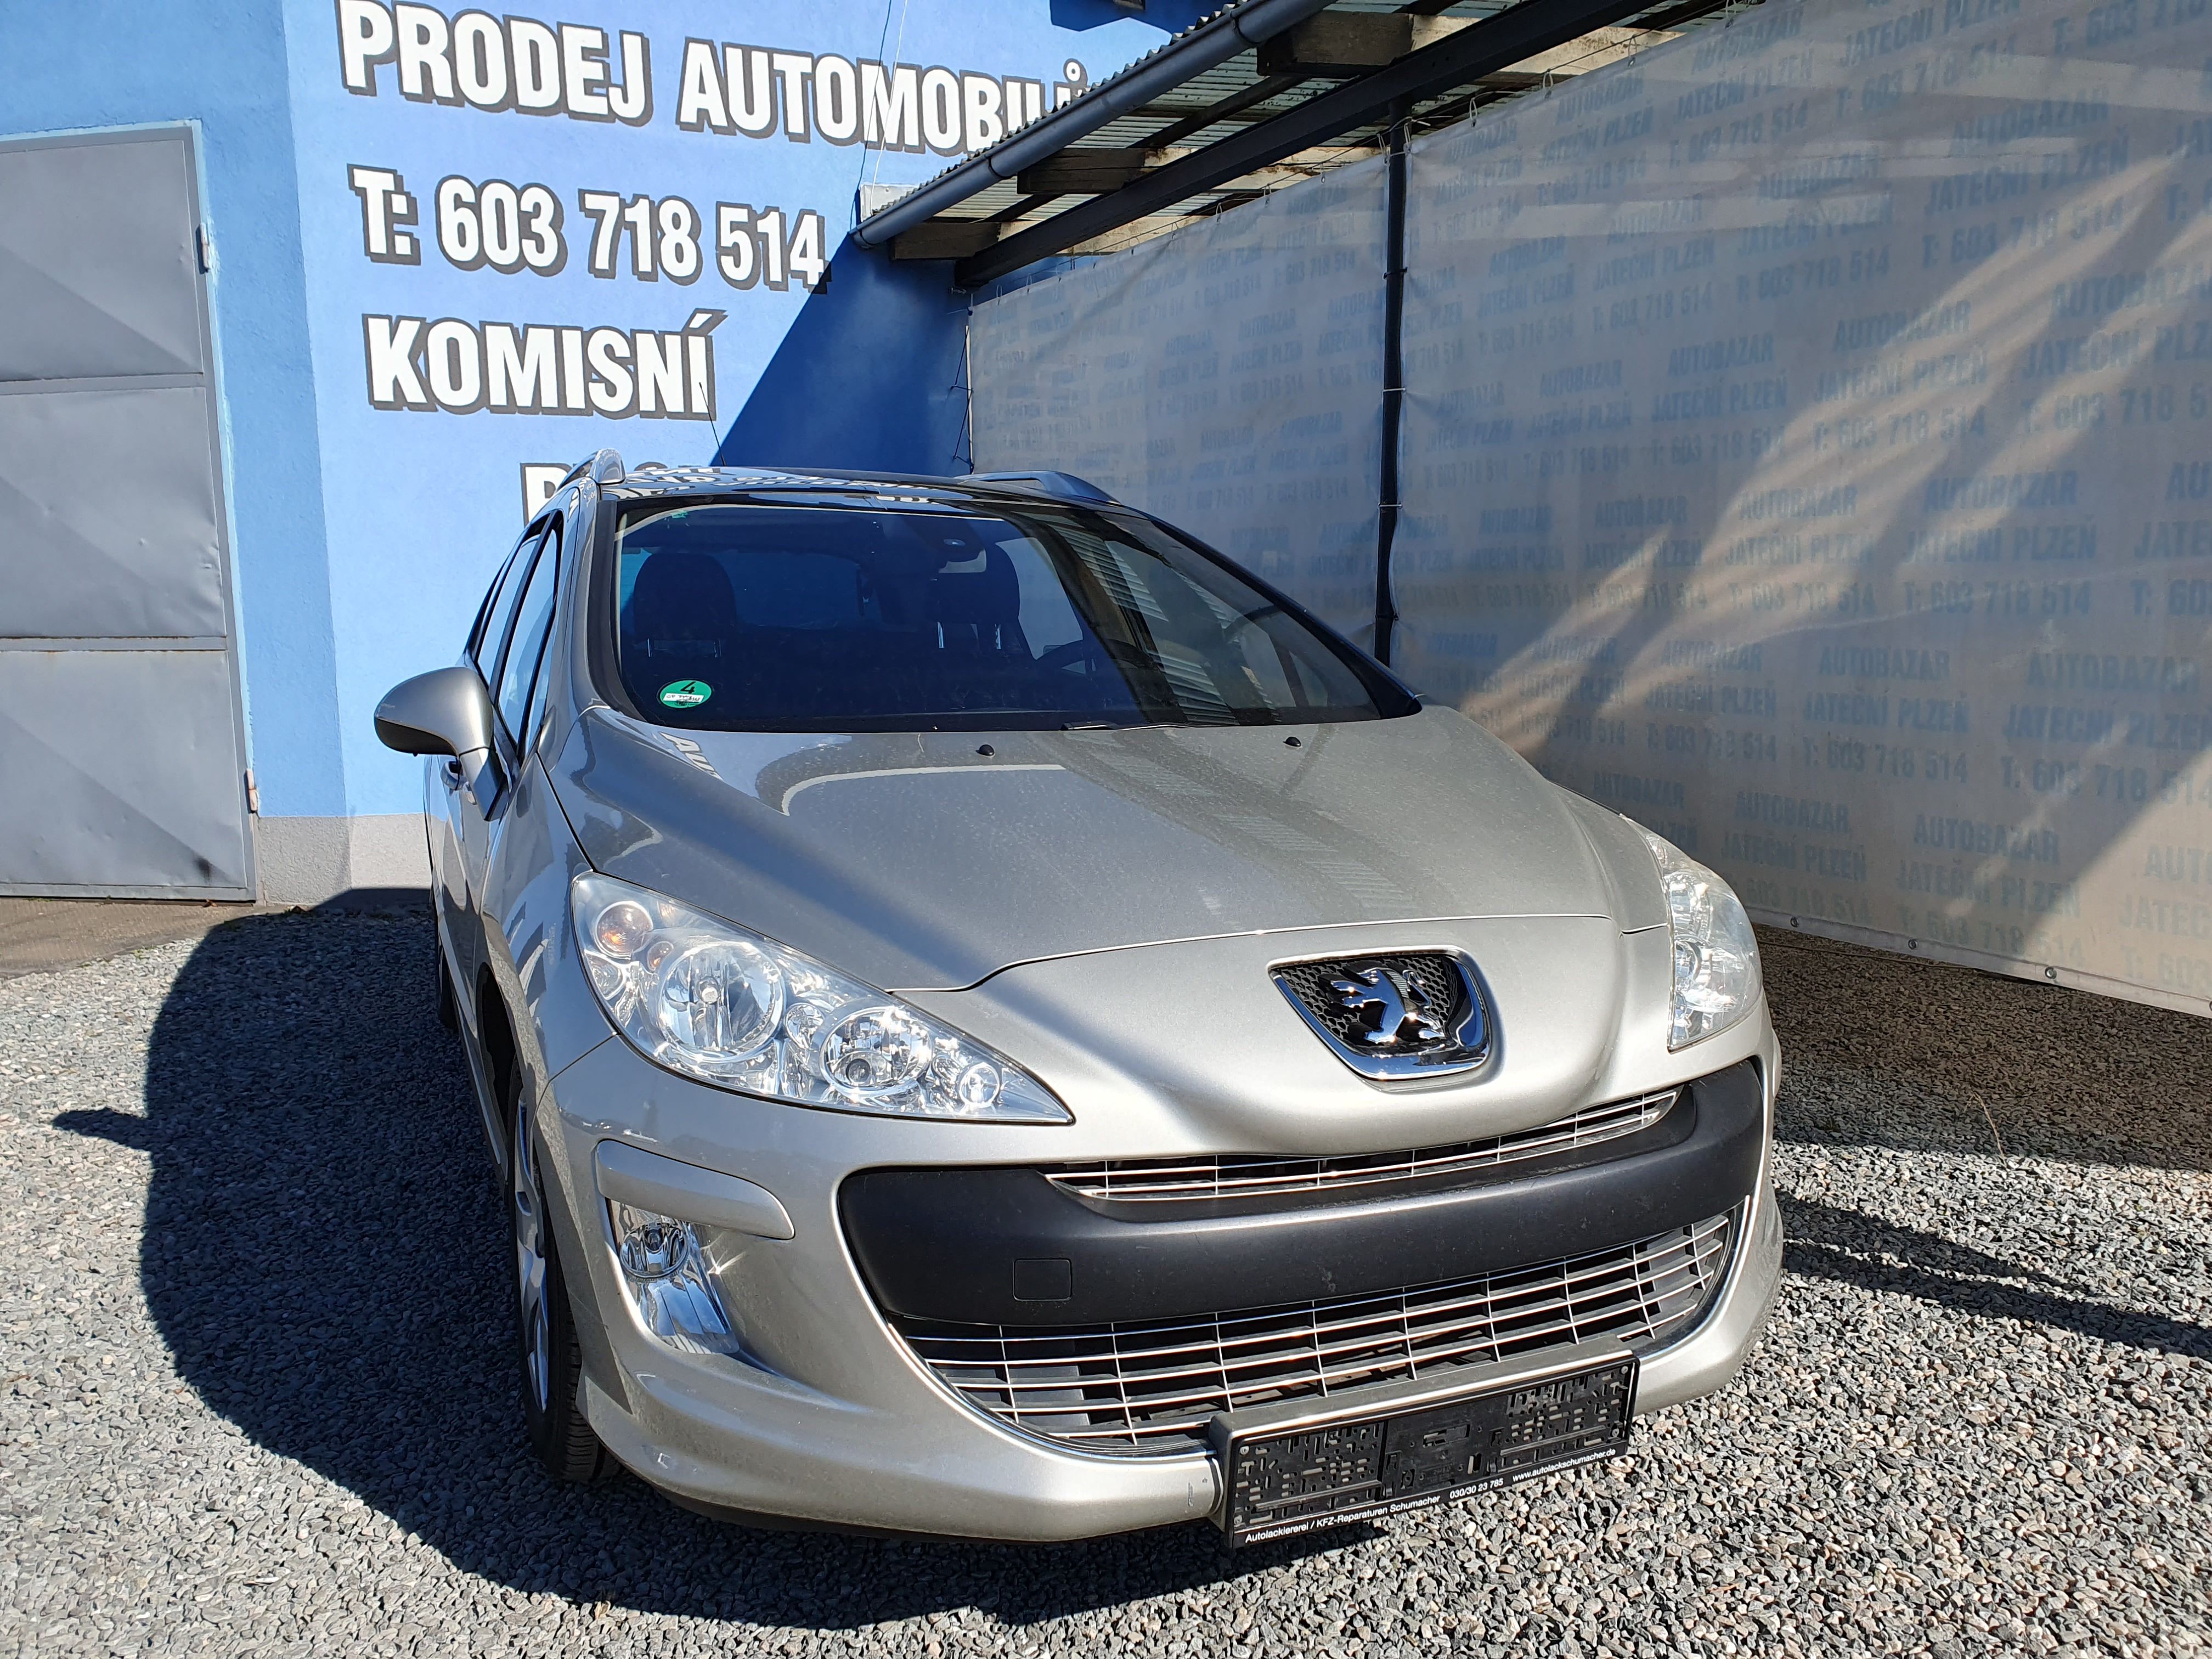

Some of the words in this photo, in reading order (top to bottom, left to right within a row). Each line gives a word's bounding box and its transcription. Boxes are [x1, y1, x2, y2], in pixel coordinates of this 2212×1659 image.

[336, 0, 652, 126] PRODEJ
[348, 165, 420, 265] T:
[438, 174, 566, 274] 603
[579, 190, 702, 286] 718
[719, 202, 833, 295] 514
[1850, 244, 1891, 282] 514
[363, 309, 727, 421] KOMISNÍ
[1668, 331, 1775, 377] AUTOBAZAR
[2119, 384, 2174, 425] 718
[1923, 470, 2079, 514] AUTOBAZAR
[1931, 580, 1974, 614] 603
[1984, 581, 2030, 616] 718
[2041, 580, 2092, 616] 514
[2168, 579, 2212, 616] 60
[1819, 646, 1951, 680] AUTOBAZAR
[680, 681, 696, 694] 4
[1827, 740, 1865, 772] 603
[1874, 743, 1915, 780] 718
[1925, 748, 1968, 783] 514
[1735, 791, 1849, 834] AUTOBAZAR
[1914, 814, 2060, 865] AUTOBAZAR
[1245, 1522, 1309, 1543] Autolackiererei
[1317, 1506, 1389, 1527] KFZ-Reparaturen
[1390, 1494, 1441, 1513] Schumacher
[1449, 1485, 1477, 1500] 030/30
[1477, 1482, 1488, 1492] 23
[1490, 1477, 1504, 1489] 785
[1513, 1448, 1617, 1482] www.autolackschumacher.de
